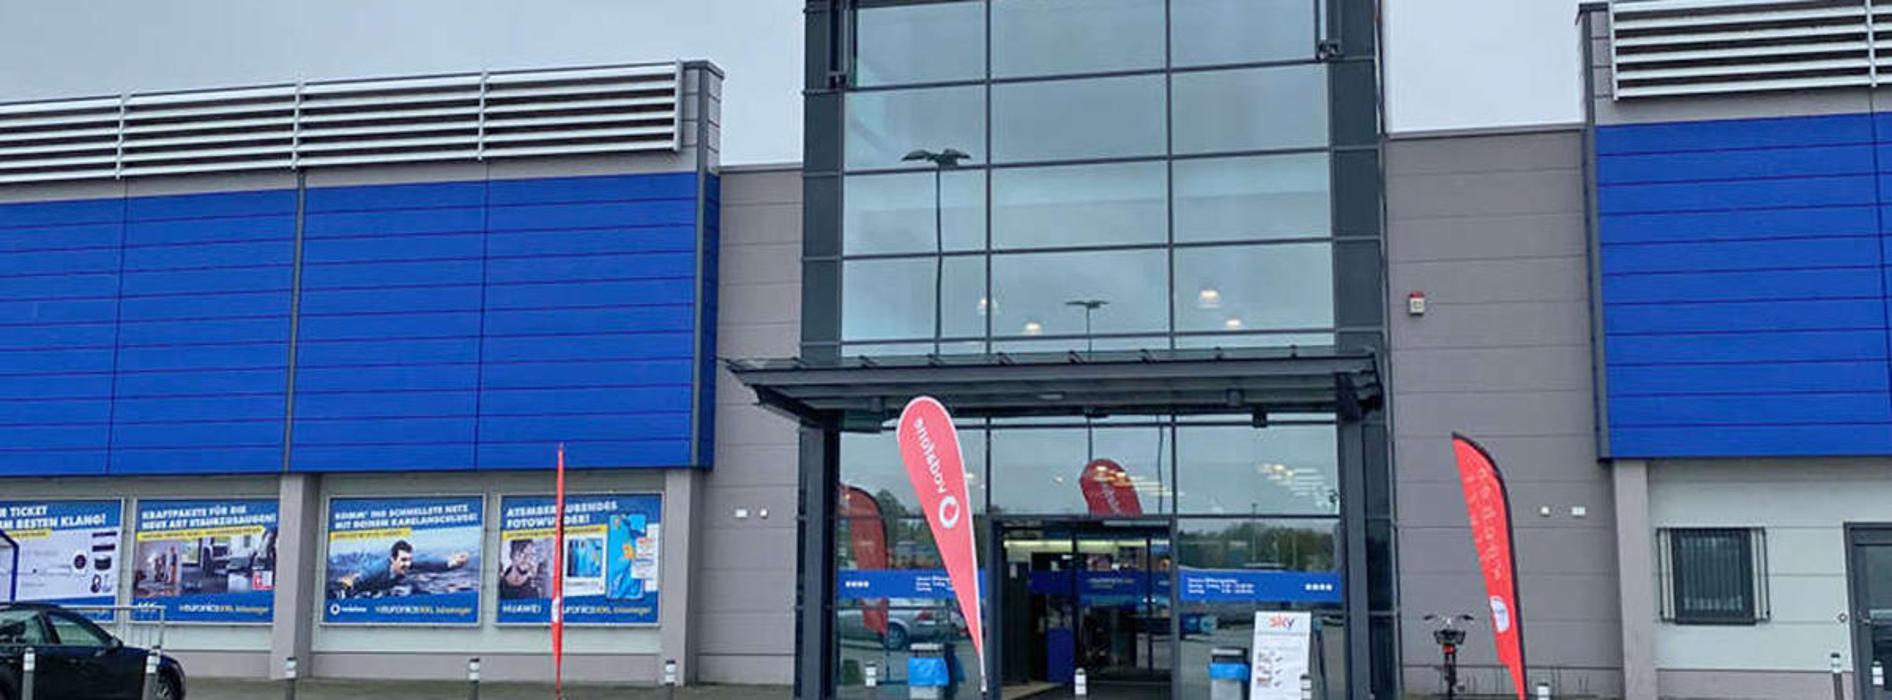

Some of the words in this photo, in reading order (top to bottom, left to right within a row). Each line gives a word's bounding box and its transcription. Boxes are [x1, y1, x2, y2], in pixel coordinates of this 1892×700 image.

[10, 504, 48, 518] TICKET
[210, 504, 227, 515] FÜR
[506, 501, 618, 518] ATEMBERUBENDES
[16, 515, 57, 529] BESTEN
[60, 513, 106, 527] KLANG!
[506, 514, 590, 529] FOTOWUDER!
[501, 604, 541, 614] HUAWEI
[1269, 614, 1295, 630] sky
